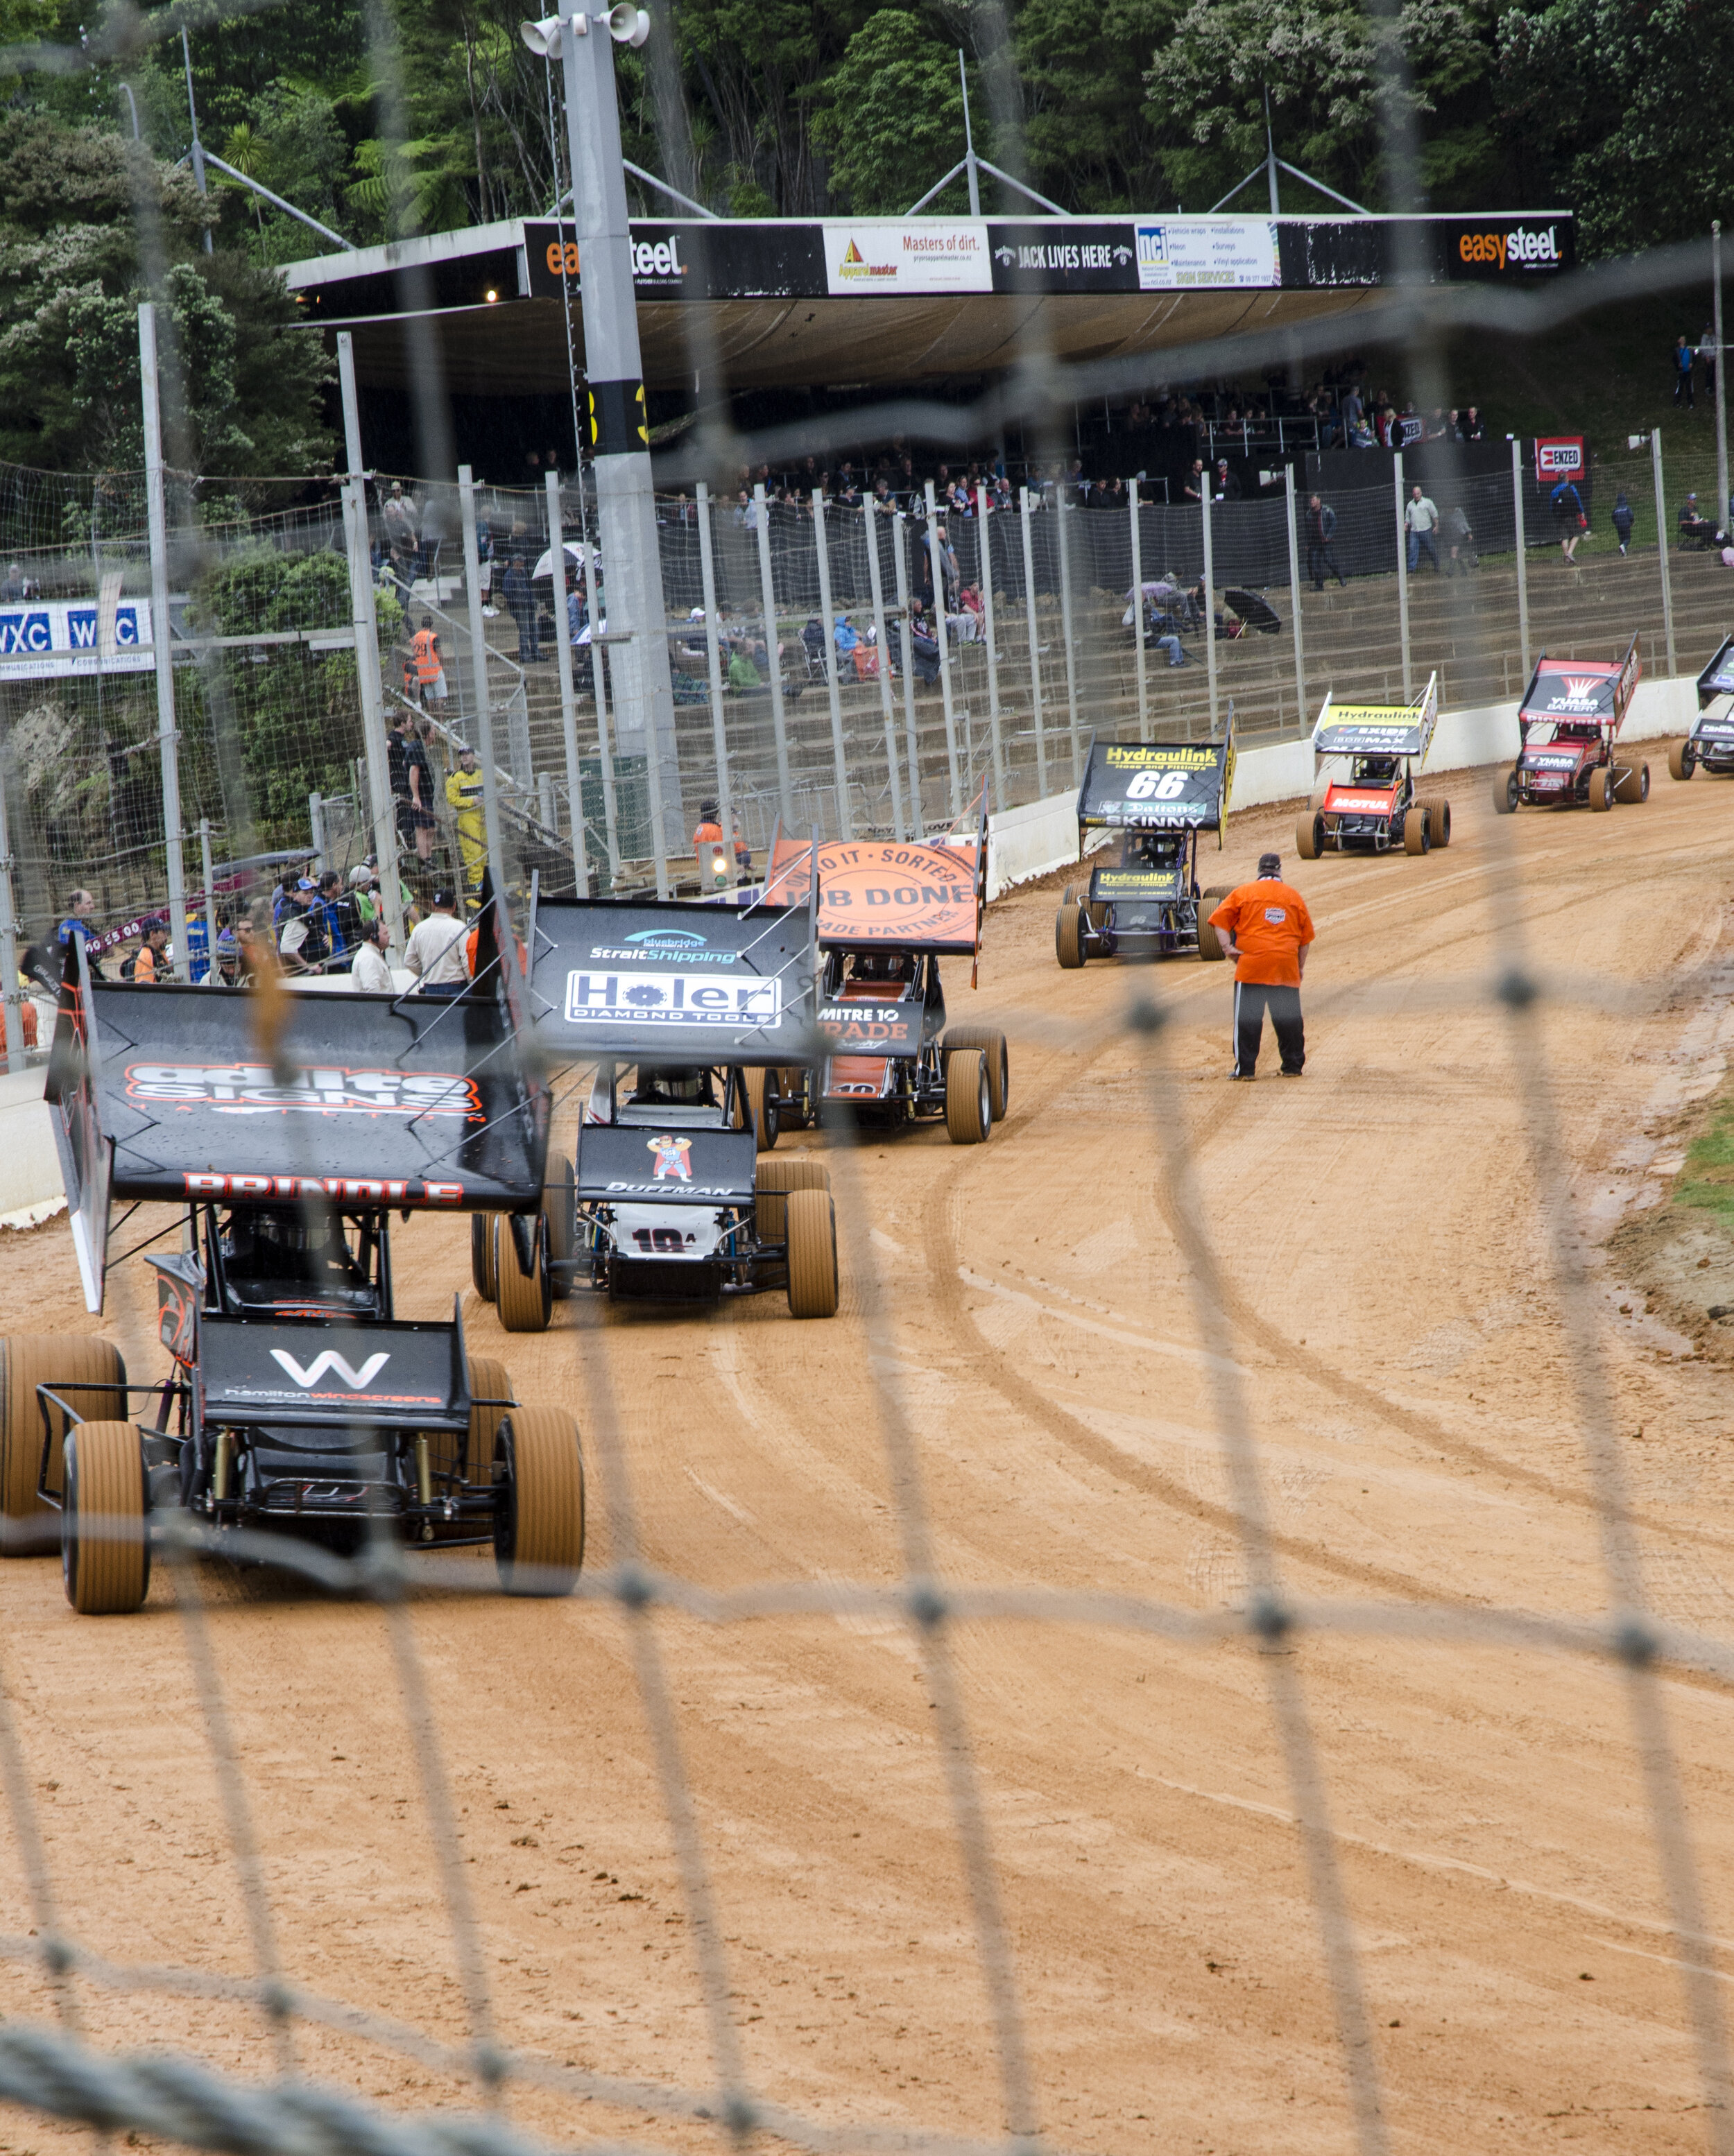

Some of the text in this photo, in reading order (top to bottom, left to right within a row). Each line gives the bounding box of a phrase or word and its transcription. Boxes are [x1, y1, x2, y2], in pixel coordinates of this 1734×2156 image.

[903, 234, 979, 251] Masters of dirt.
[1138, 228, 1169, 261] nci
[1215, 243, 1235, 252] Surveys
[1018, 245, 1046, 268] JACK
[1048, 245, 1079, 268] LIVES
[1081, 245, 1112, 268] HERE
[839, 263, 898, 280] Apparelmaster
[1554, 450, 1578, 465] ENZED
[1547, 703, 1597, 712] BATTERY
[1552, 697, 1598, 706] YUASA
[1339, 711, 1419, 719] Hydraulink
[1106, 747, 1217, 762] Hydraulink
[1126, 770, 1188, 799] 66
[1332, 798, 1389, 809] MOTUL
[1106, 816, 1204, 828] SKINNY
[841, 850, 859, 865] IT
[881, 849, 957, 883] SORTED
[1100, 872, 1174, 882] Hydraulink
[866, 885, 974, 906] DONE
[818, 919, 861, 935] ADE
[644, 938, 705, 947] bluebridge
[590, 947, 737, 965] StraitShipping
[574, 1009, 769, 1024] DIAMOND TOOLS
[817, 1008, 899, 1021] MITRE 10
[134, 1084, 474, 1108] SIGNS
[182, 1173, 464, 1207] BRINDLE
[606, 1181, 733, 1196] DUFFMAN
